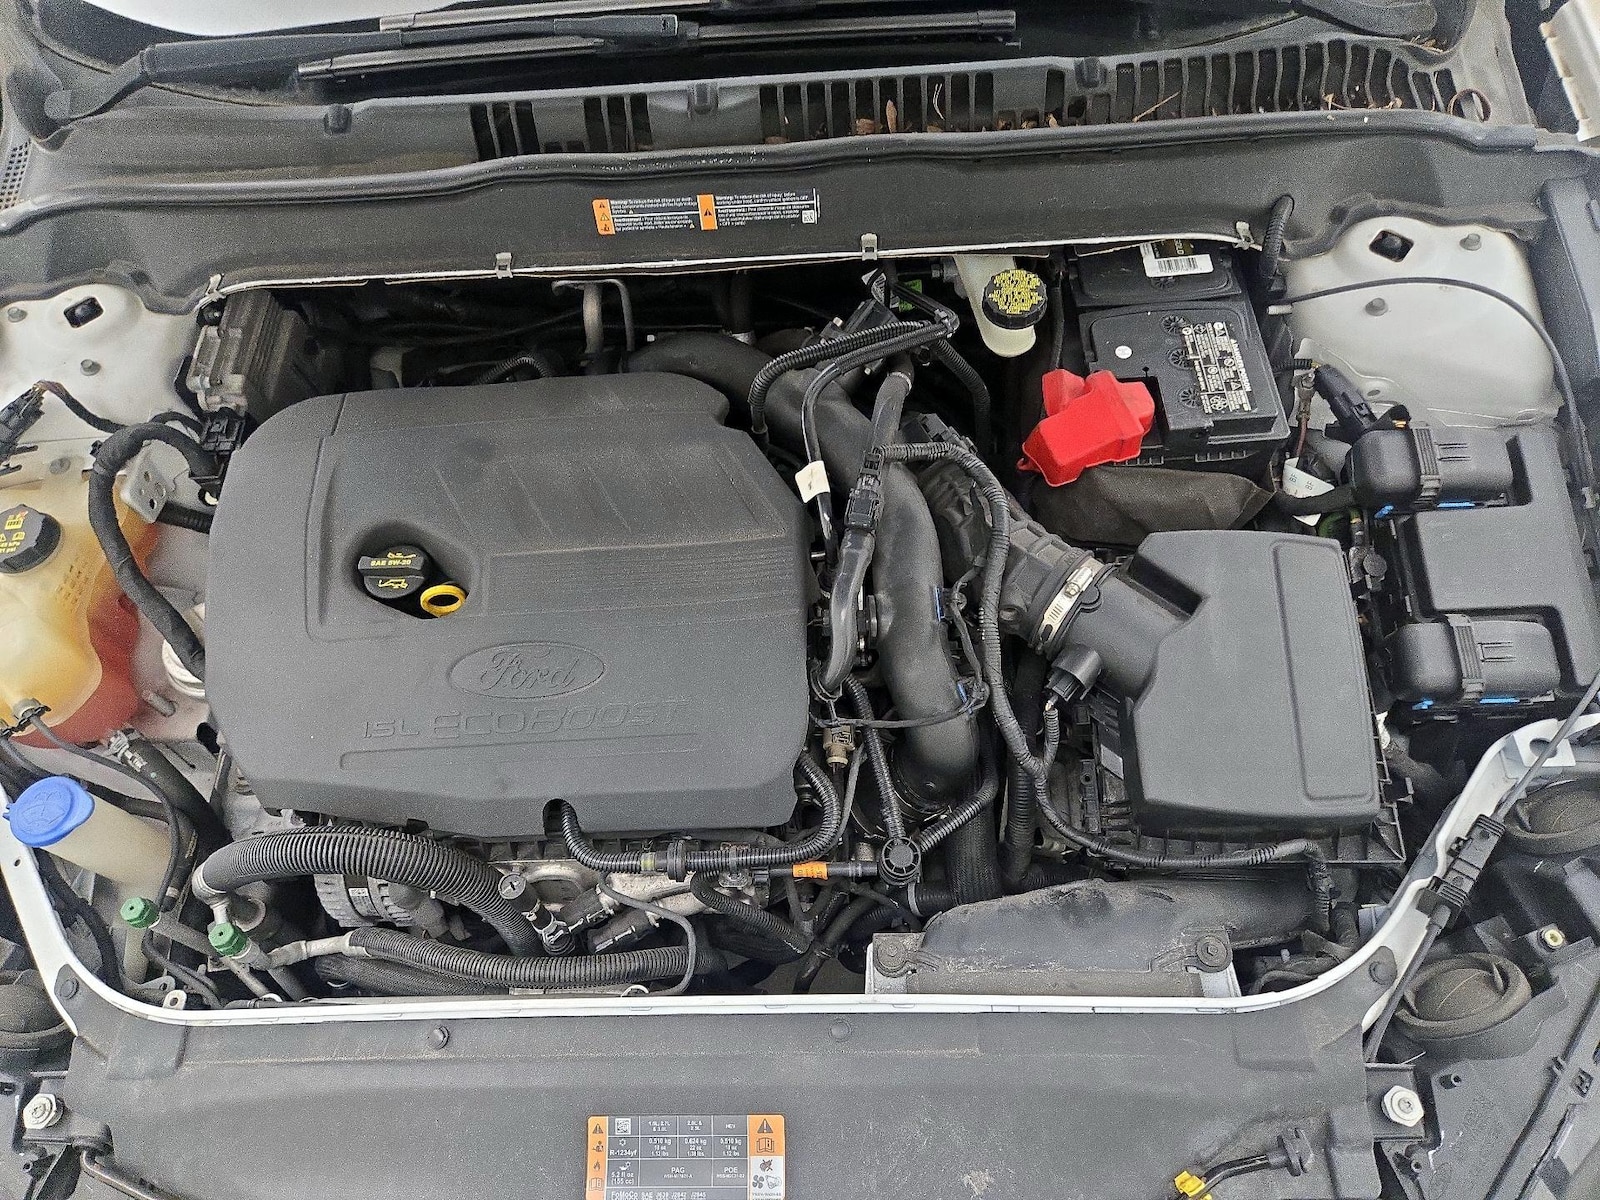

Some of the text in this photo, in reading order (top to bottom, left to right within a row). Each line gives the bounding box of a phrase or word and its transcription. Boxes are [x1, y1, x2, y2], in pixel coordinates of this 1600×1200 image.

[479, 648, 582, 692] Ford
[664, 1138, 672, 1146] kg
[700, 1138, 707, 1146] kg
[735, 1138, 742, 1146] kg
[609, 1149, 637, 1158] R-1234yf
[670, 1166, 686, 1174] PAG
[611, 1177, 635, 1185] (155 cc)
